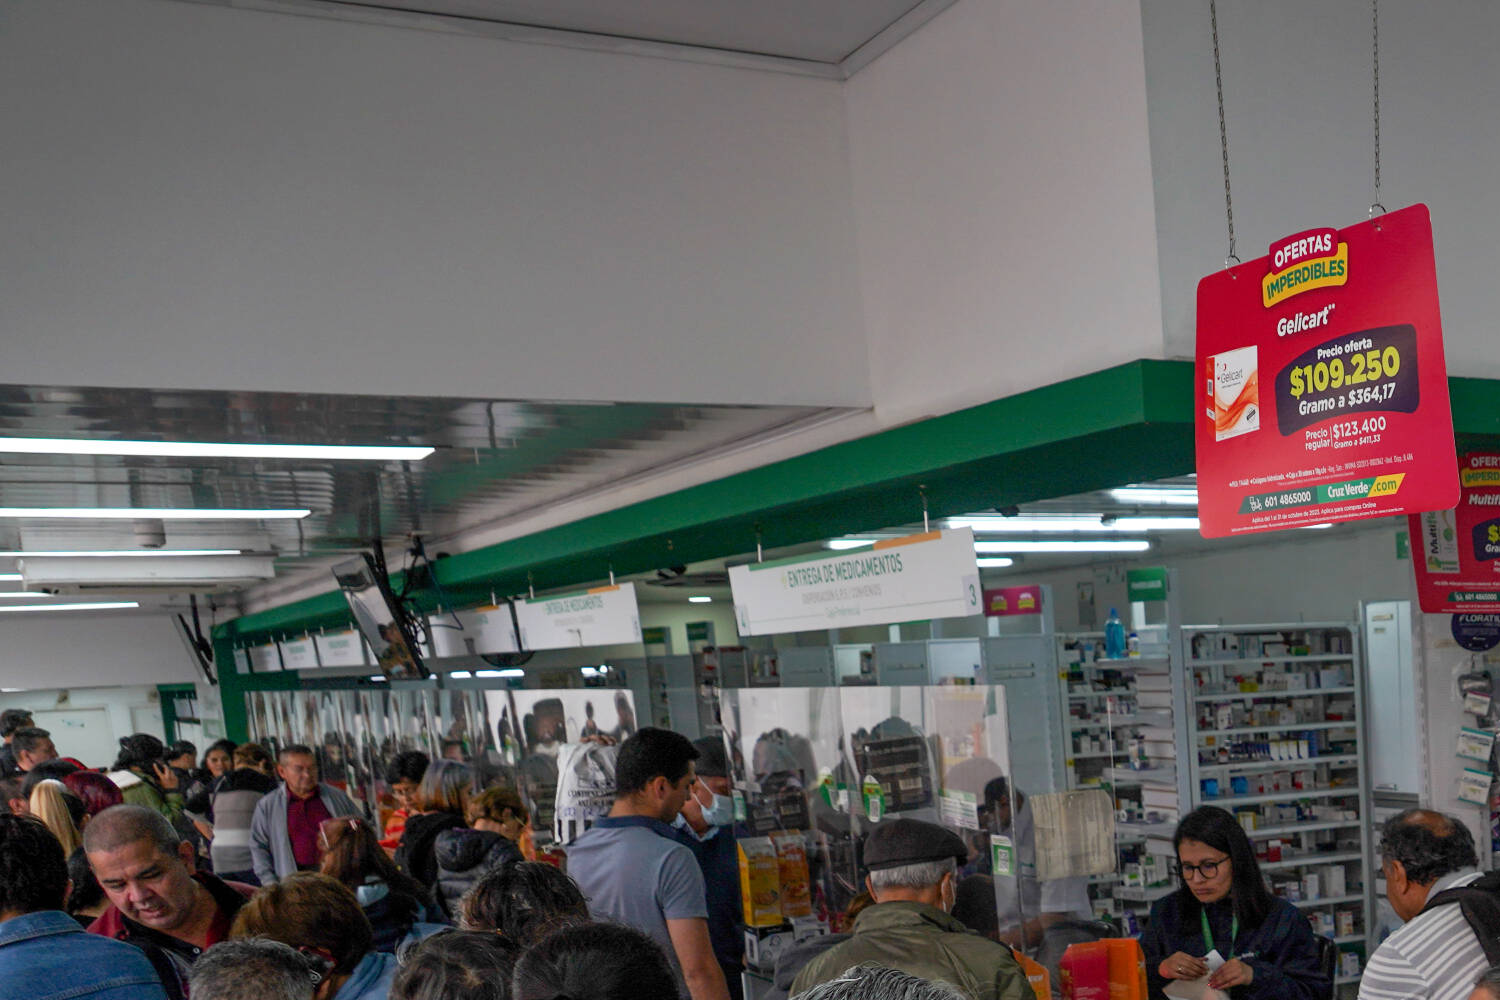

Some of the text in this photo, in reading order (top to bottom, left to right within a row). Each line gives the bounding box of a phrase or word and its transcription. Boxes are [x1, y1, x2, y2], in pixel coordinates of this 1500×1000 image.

[1274, 233, 1332, 268] OFERTAS
[1266, 259, 1345, 300] IMPERDIBLES
[1318, 338, 1372, 360] Precio oferta
[1221, 369, 1243, 383] Gelicart
[1290, 346, 1400, 400] $109.250
[1299, 383, 1396, 415] Gramo a $364,17
[1306, 416, 1386, 440] Precio $123.400
[1305, 437, 1330, 451] regular
[1334, 439, 1352, 449] Gramo
[1264, 495, 1277, 508] 601
[1280, 491, 1311, 505] 4865000
[788, 553, 903, 588] ENTREGA DE MEDICAMENTOS
[970, 584, 977, 606] 3
